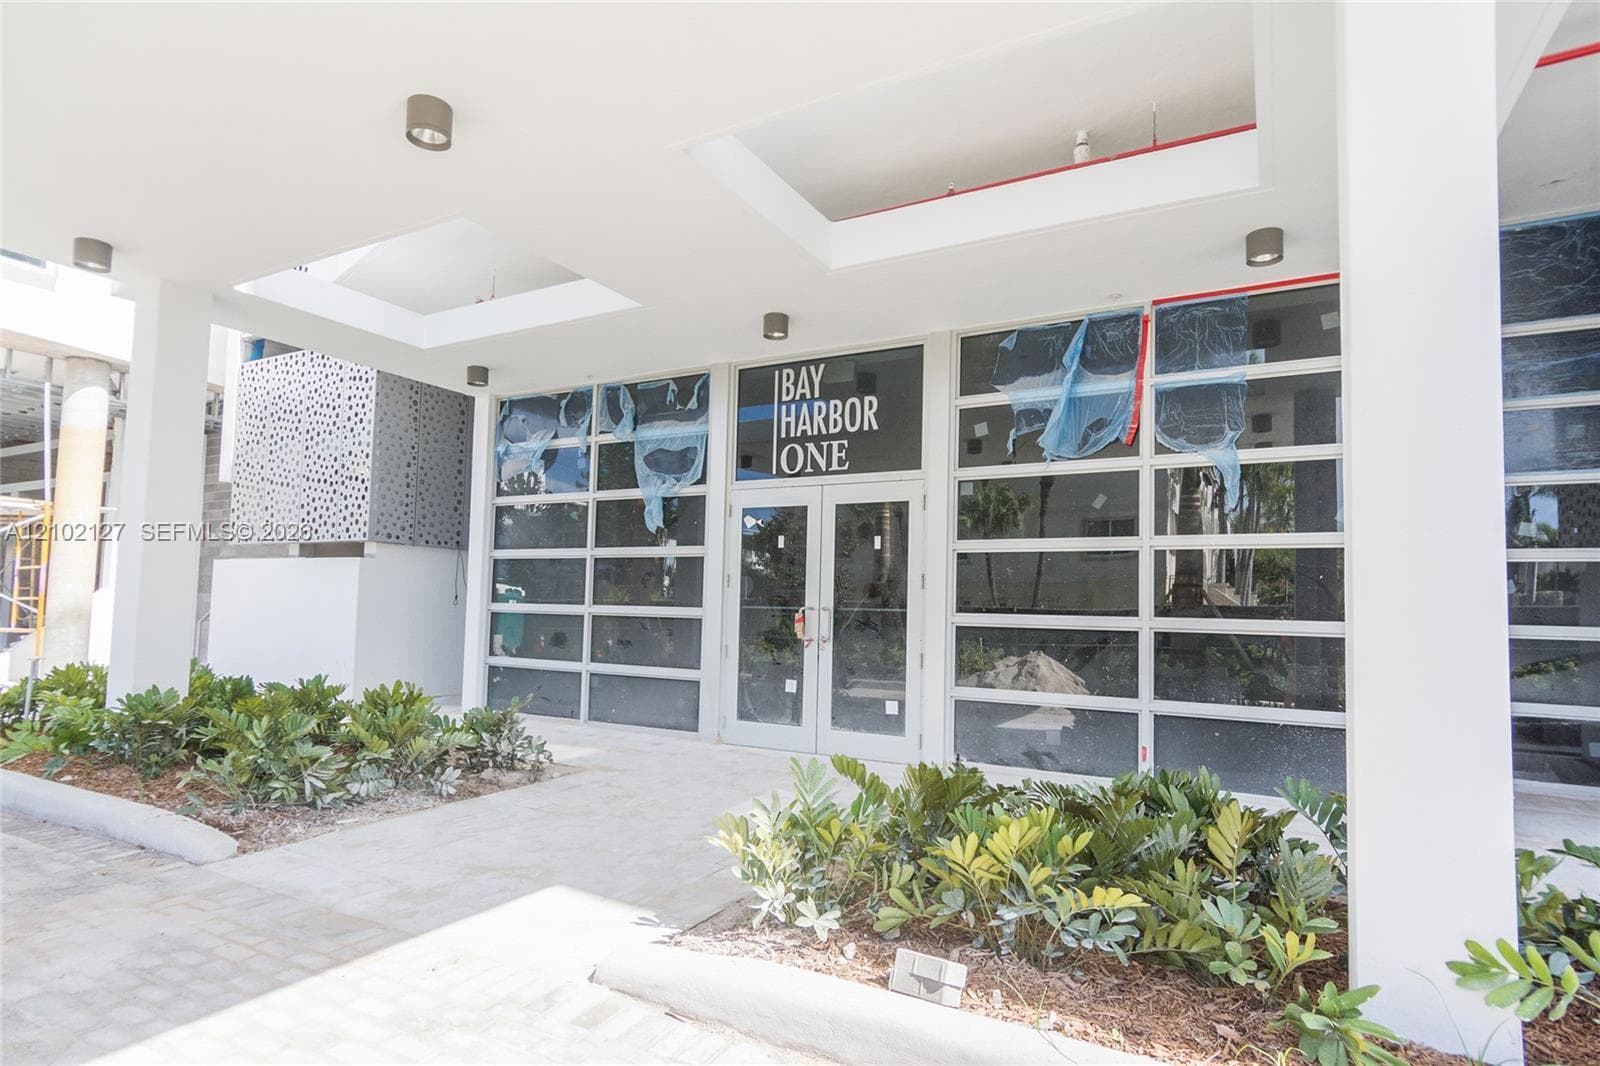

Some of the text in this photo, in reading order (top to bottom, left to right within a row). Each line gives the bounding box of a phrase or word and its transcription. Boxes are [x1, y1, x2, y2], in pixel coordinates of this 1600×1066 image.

[781, 363, 826, 402] BAY
[780, 395, 879, 438] HARBOR
[780, 440, 850, 475] ONE
